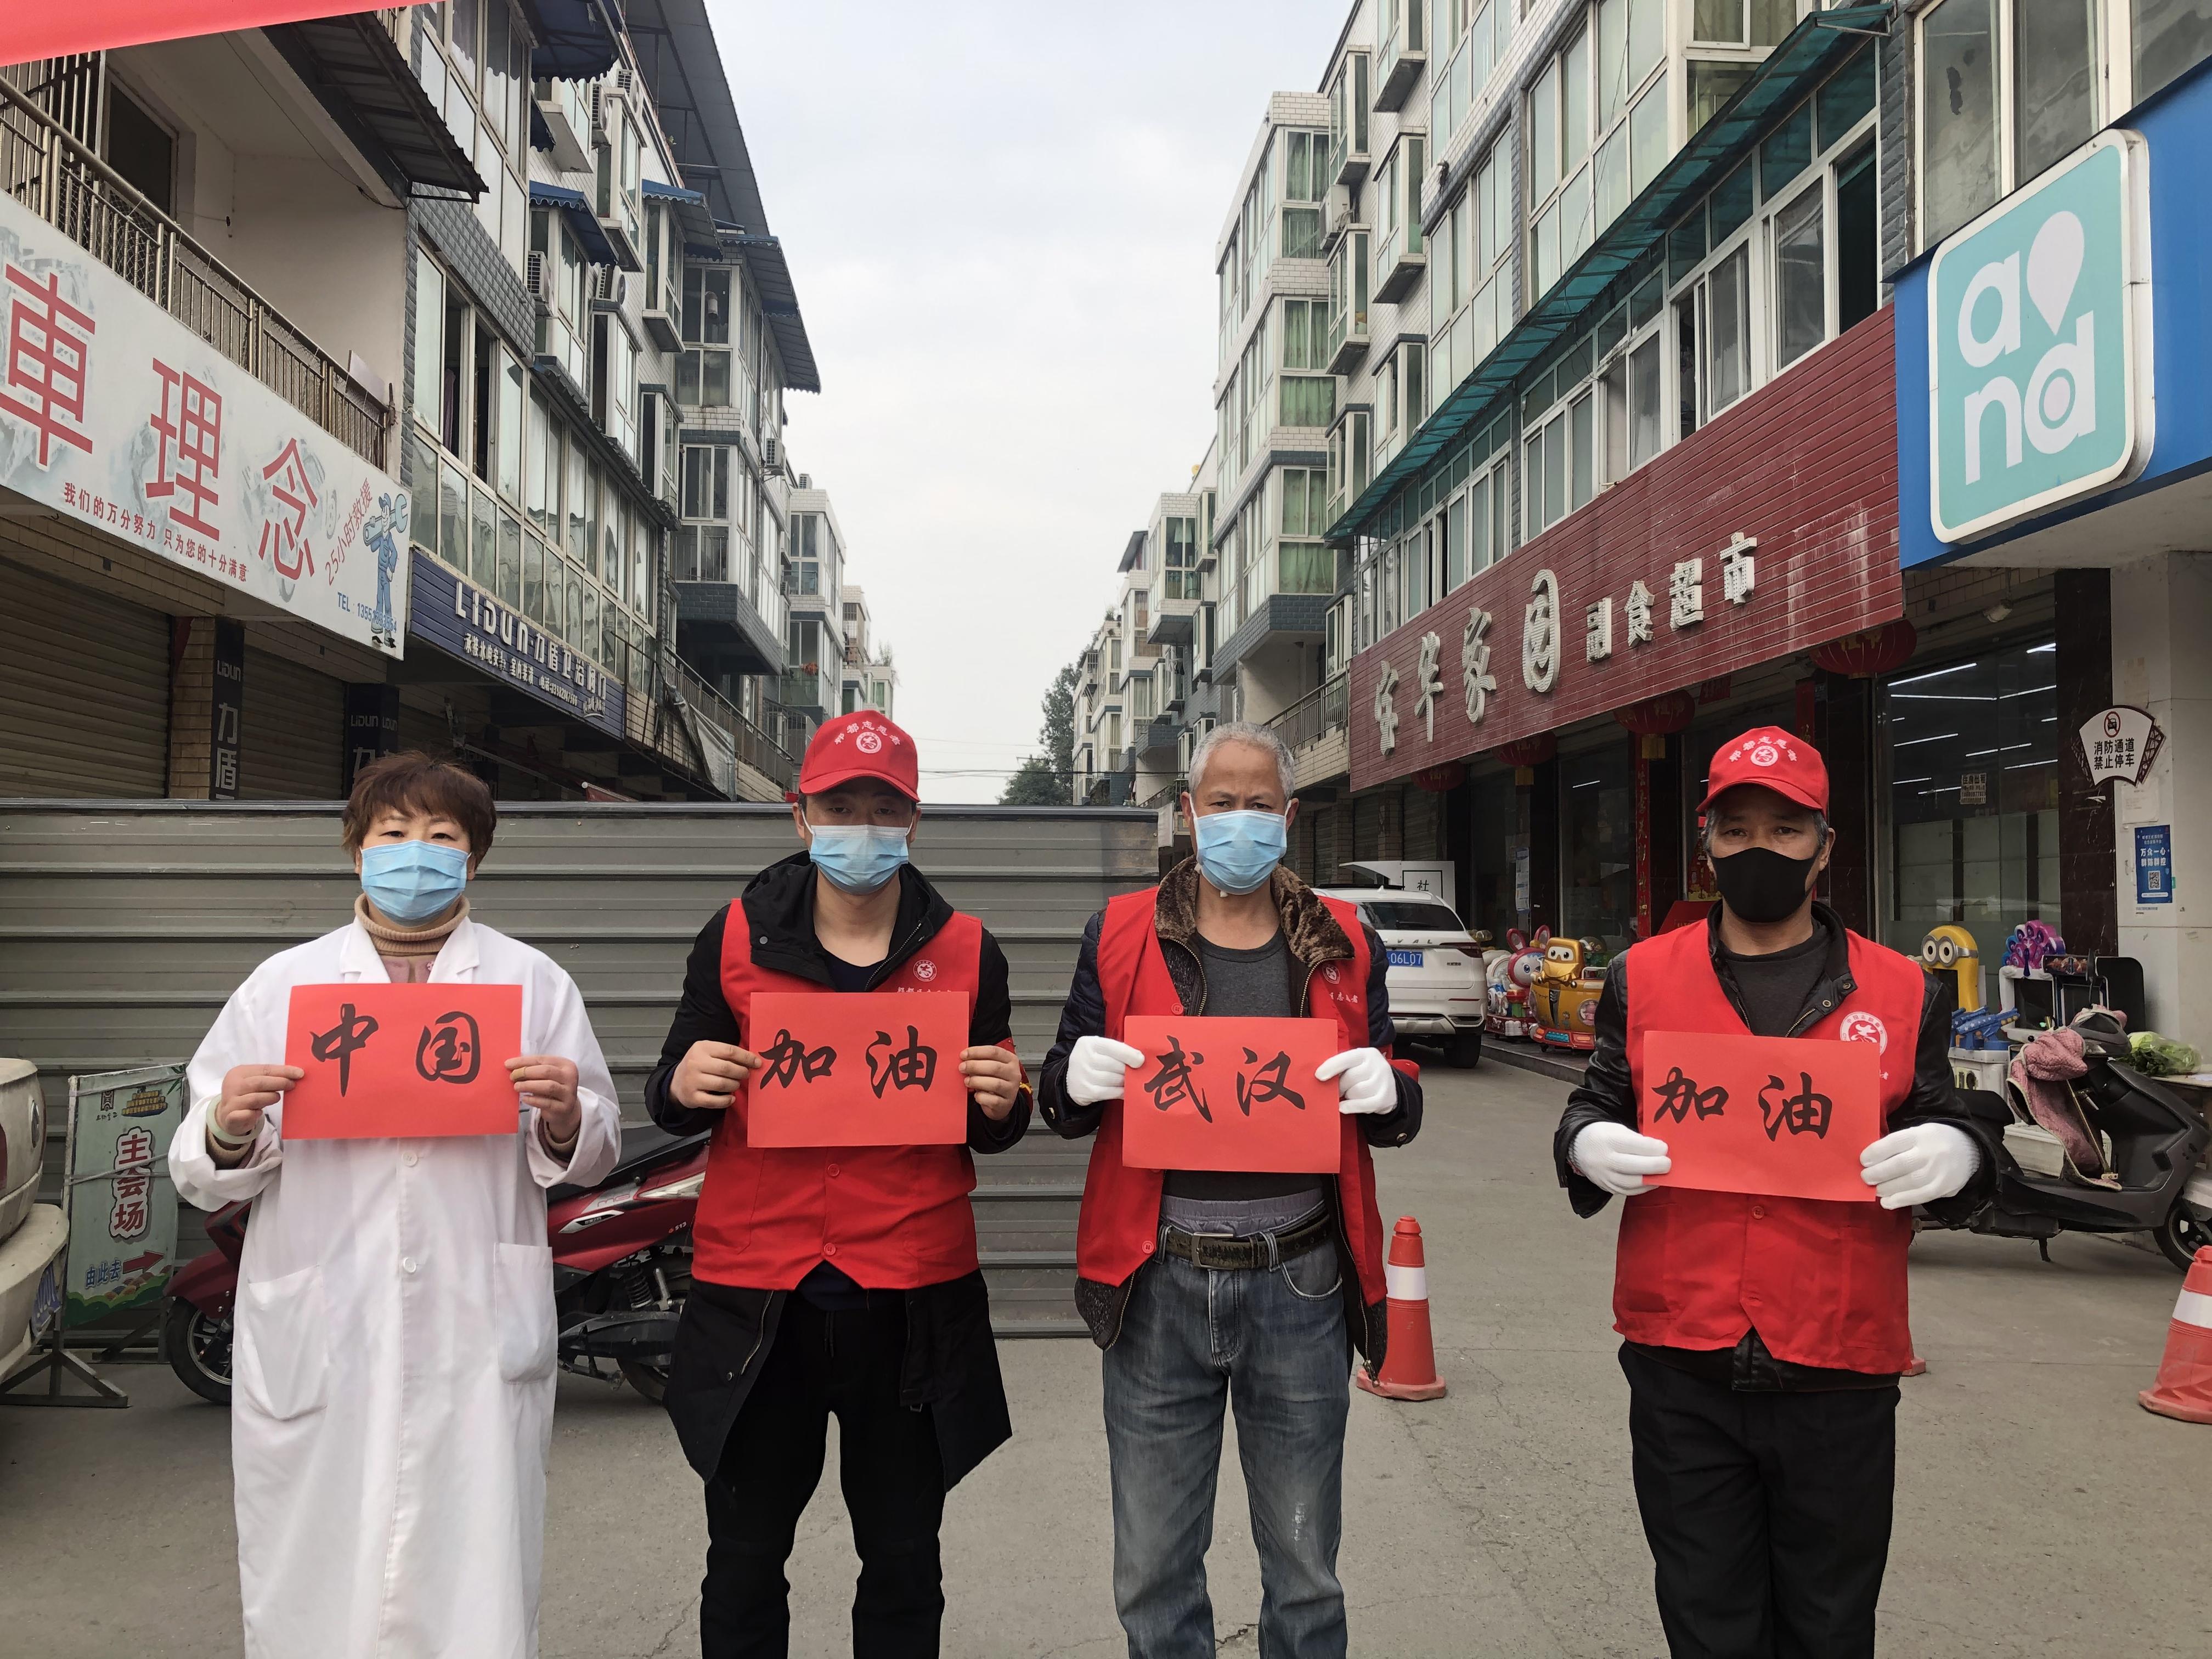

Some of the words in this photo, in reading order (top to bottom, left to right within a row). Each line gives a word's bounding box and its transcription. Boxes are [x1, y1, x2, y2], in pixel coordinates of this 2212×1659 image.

[64, 482, 156, 540] 我们的万分努力
[163, 528, 247, 582] 只为您的十分满意
[325, 477, 373, 586] 25小时救援
[215, 702, 238, 800] 力盾
[2094, 737, 2135, 755] 消防通道
[2094, 753, 2135, 770] 禁止停车
[1417, 879, 1430, 891] 社
[2140, 847, 2166, 857] 万众一心
[309, 1003, 481, 1097] 中国
[759, 1025, 938, 1099] 加油
[1144, 1035, 1305, 1124] 武汉
[1651, 1066, 1832, 1142] 加油
[114, 1133, 148, 1232] 主会场
[86, 1258, 121, 1289] 由此去
